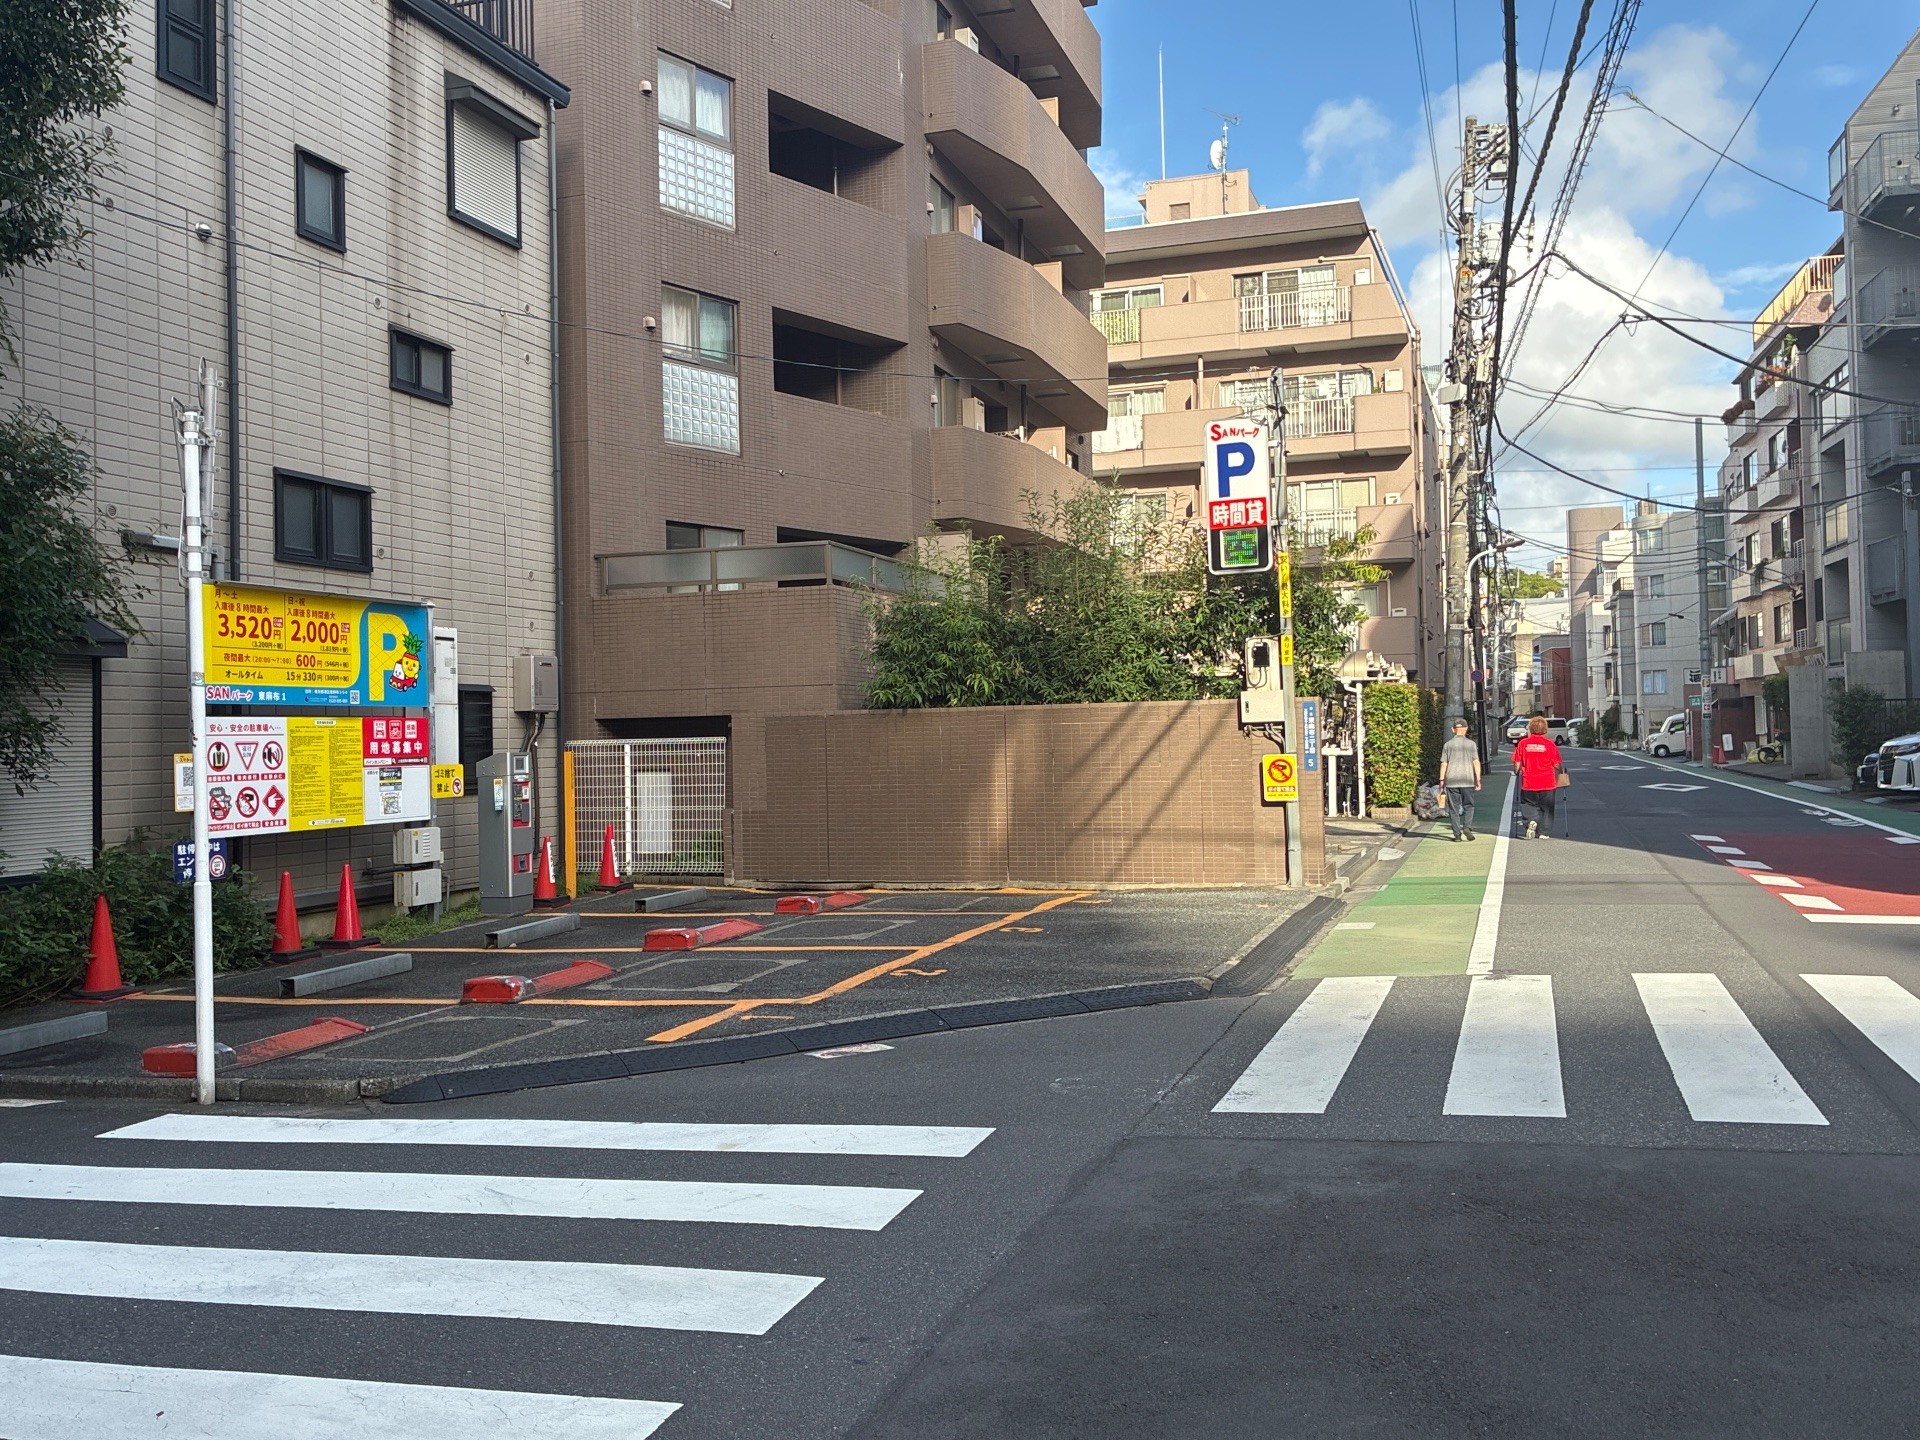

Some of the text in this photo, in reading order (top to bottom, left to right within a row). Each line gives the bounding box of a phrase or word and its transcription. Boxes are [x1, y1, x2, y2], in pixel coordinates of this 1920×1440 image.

[1216, 441, 1256, 499] P
[1212, 500, 1264, 528] 時間貸
[368, 612, 411, 702] P
[225, 670, 264, 680] オールタイム
[369, 740, 423, 755] 用地募集中
[1307, 758, 1314, 767] 5
[434, 768, 456, 779] ゴミ捨て
[436, 782, 450, 794] 禁止
